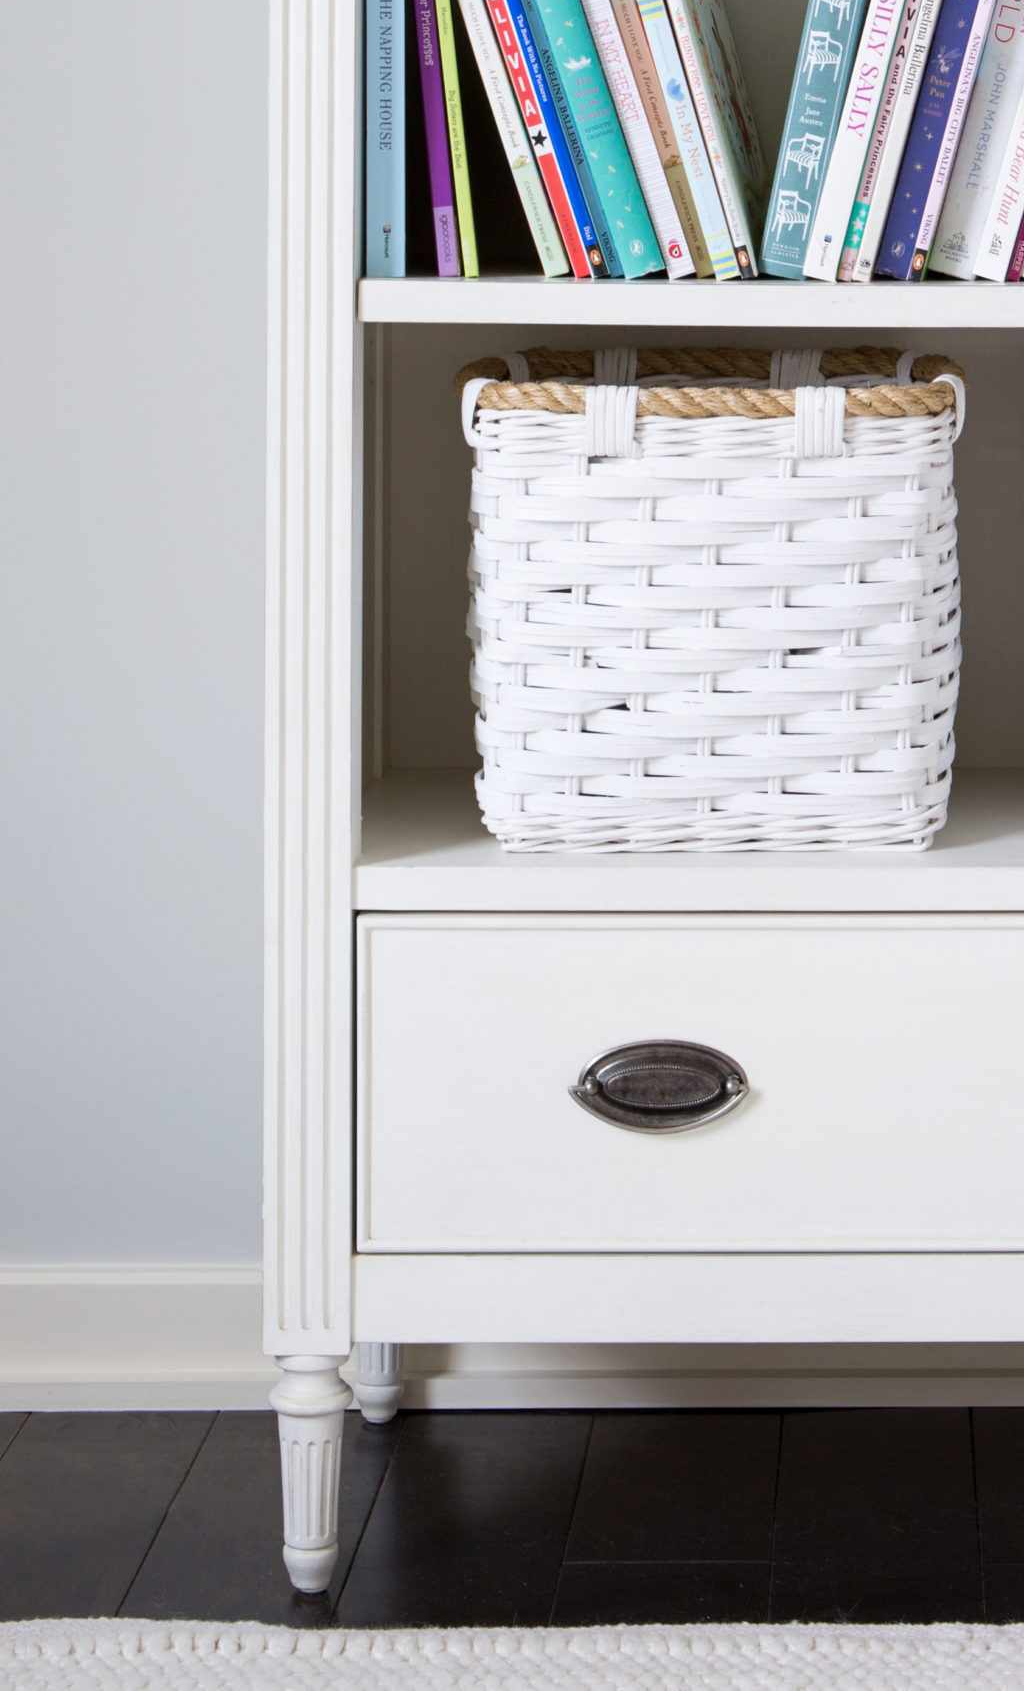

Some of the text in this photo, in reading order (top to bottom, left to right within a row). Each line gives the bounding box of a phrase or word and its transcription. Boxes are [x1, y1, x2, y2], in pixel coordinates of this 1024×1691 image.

[379, 26, 391, 91] NAPPING
[419, 9, 434, 65] Princesses
[515, 14, 548, 102] The Book With No Pictures
[594, 18, 639, 123] IN MY HEART
[890, 63, 901, 84] and
[902, 43, 926, 96] Ballerina
[930, 75, 951, 87] Peter
[540, 46, 585, 166] ANGELINA BALLERINA
[804, 93, 826, 104] Emma
[804, 106, 820, 116] Jane
[845, 62, 880, 137] SALLY
[885, 87, 895, 105] the
[930, 88, 945, 98] Pan
[935, 32, 982, 185] ANGELINA'S BIG CITY BALLET
[379, 99, 391, 149] HOUSE
[675, 104, 706, 179] In My Nest
[800, 115, 823, 127] Austen
[876, 108, 890, 135] Fairy
[965, 62, 1008, 191] JOHN MARSHALL
[862, 139, 883, 197] Princesses
[996, 183, 1020, 225] Hunt
[582, 226, 592, 240] Dial
[599, 231, 616, 262] VIKING
[919, 213, 933, 244] VIKING
